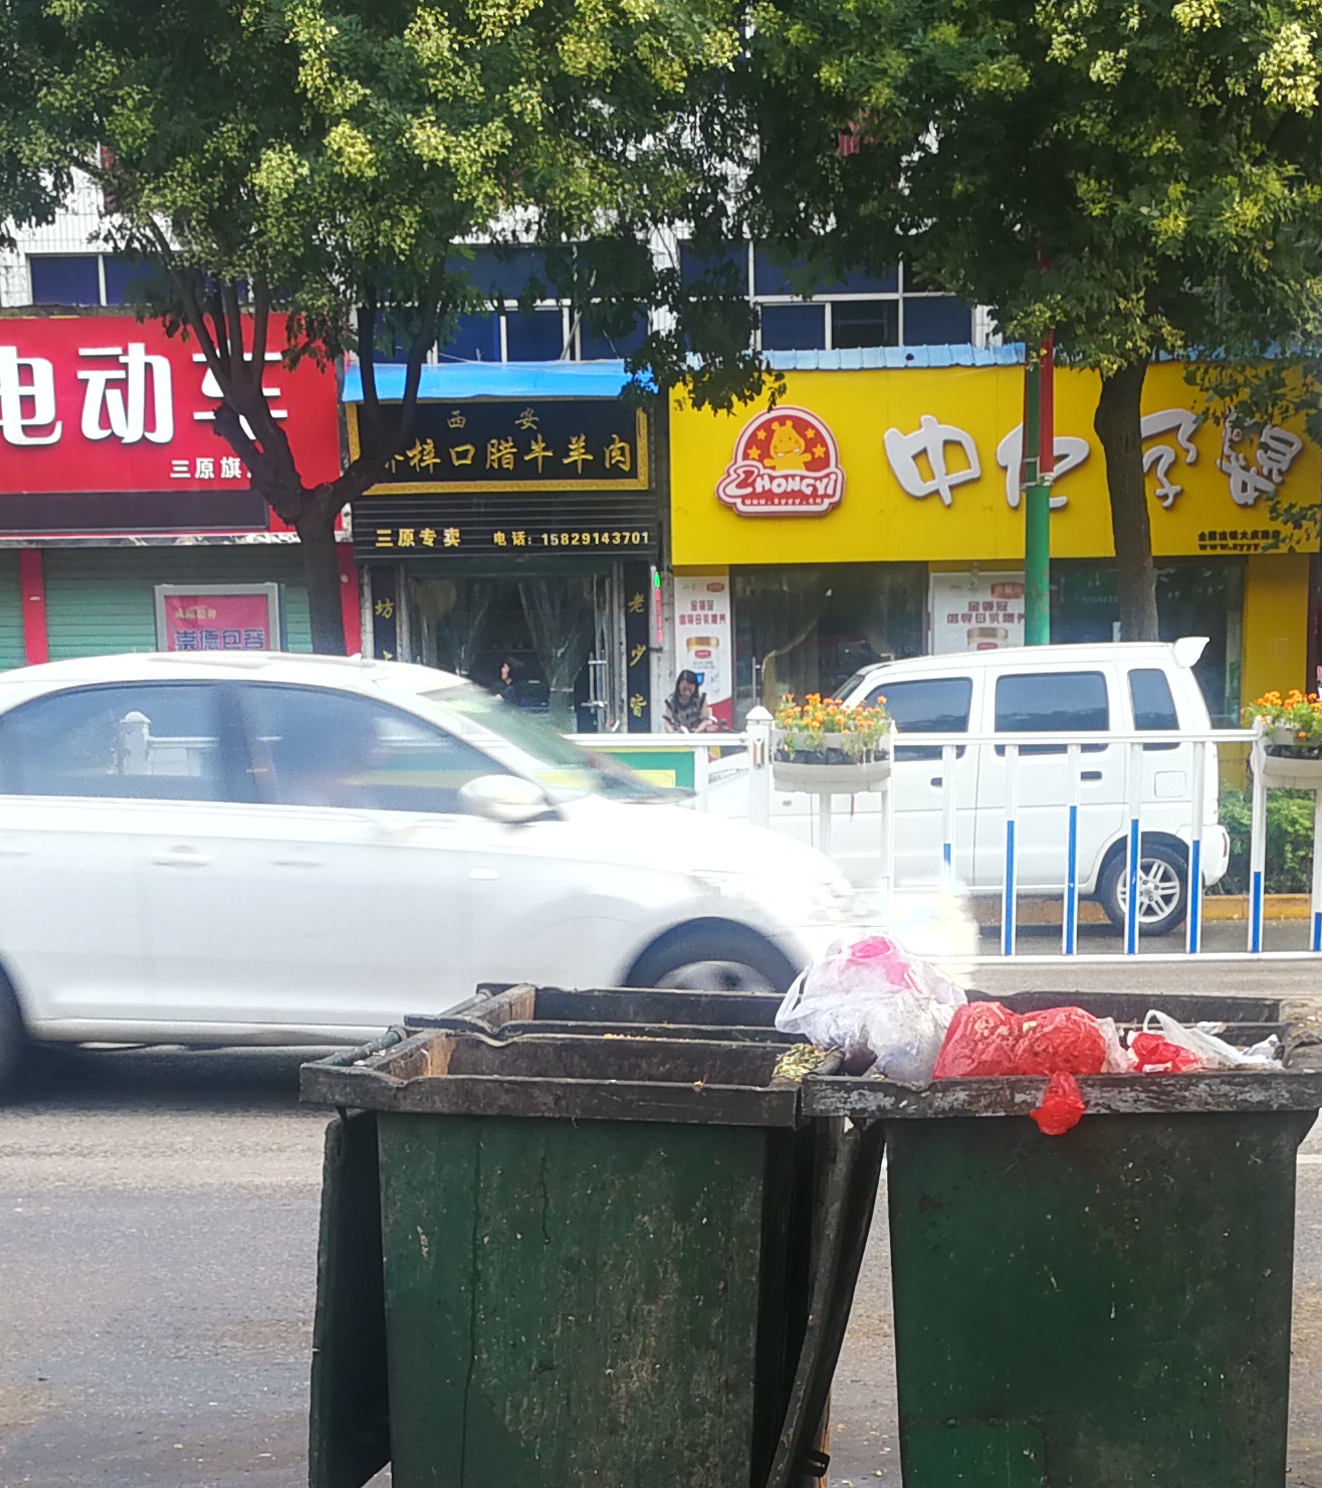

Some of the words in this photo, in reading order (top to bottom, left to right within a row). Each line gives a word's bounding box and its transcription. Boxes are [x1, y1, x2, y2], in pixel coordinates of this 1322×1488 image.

[169, 456, 253, 479] 三原旗
[375, 528, 462, 548] 三原专卖
